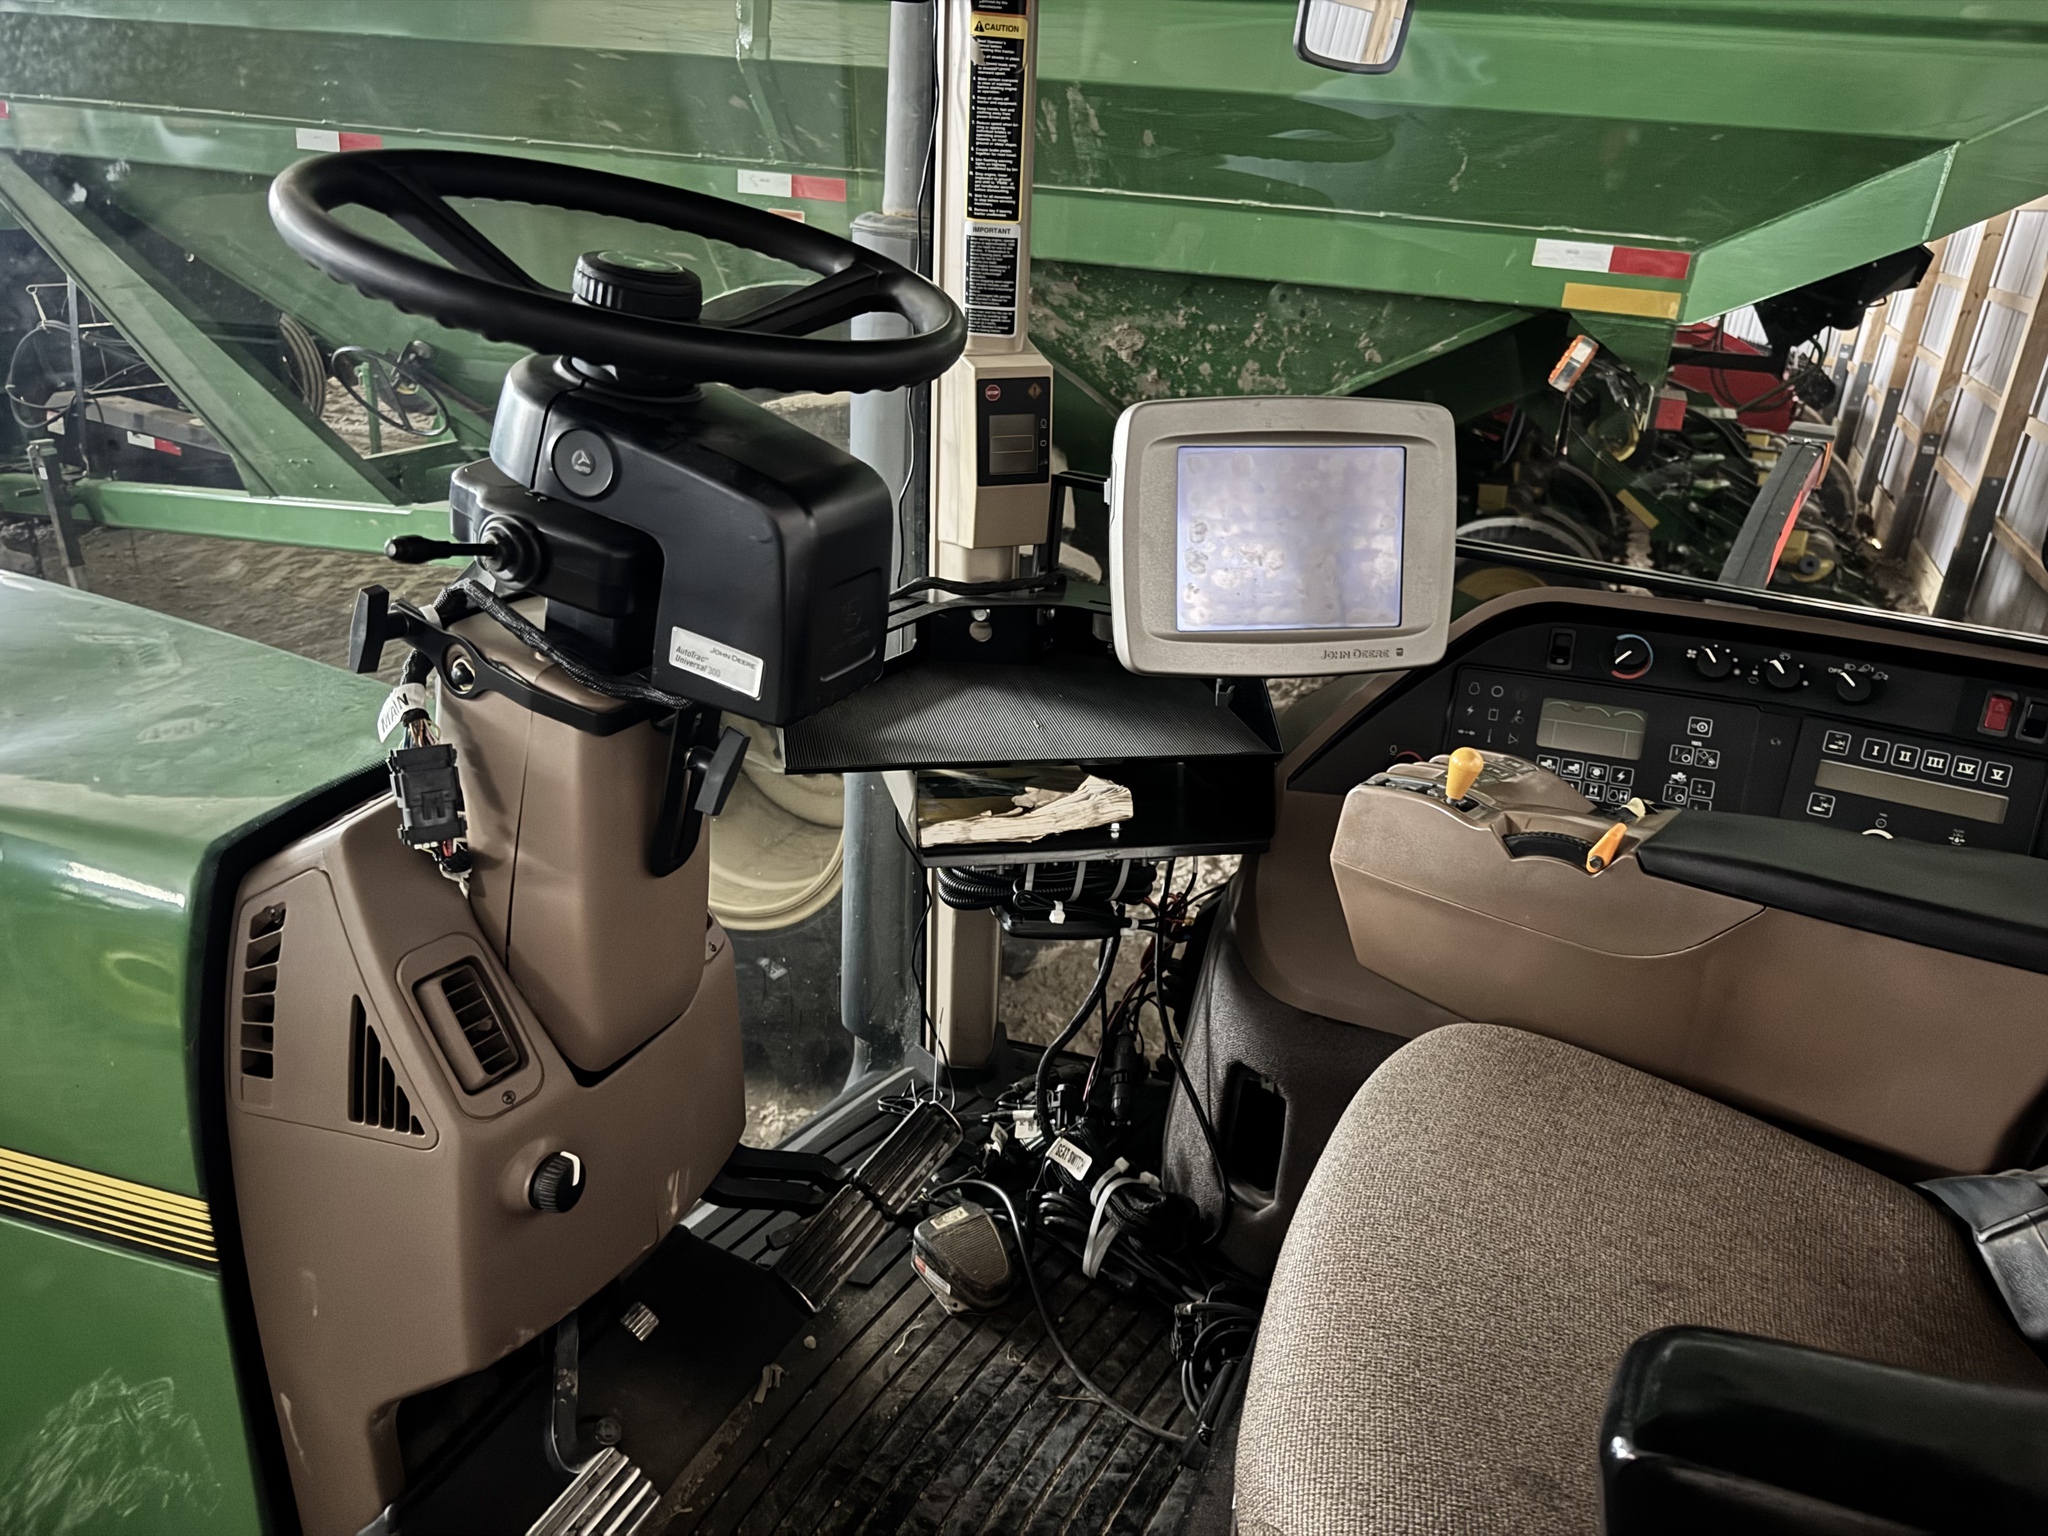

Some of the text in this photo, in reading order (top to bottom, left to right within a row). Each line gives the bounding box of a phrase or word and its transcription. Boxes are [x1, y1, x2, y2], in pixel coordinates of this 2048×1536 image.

[984, 23, 1020, 33] CAUTION
[709, 647, 756, 669] JOHN DEERE
[1321, 648, 1390, 660] JOHN DEERE
[675, 654, 721, 678] Universal 300
[380, 692, 410, 734] MAIN
[1899, 751, 1911, 762] II
[1927, 756, 1944, 768] III
[1957, 762, 1975, 774] IV
[1991, 769, 2004, 780] V
[1055, 1143, 1070, 1160] SEAT
